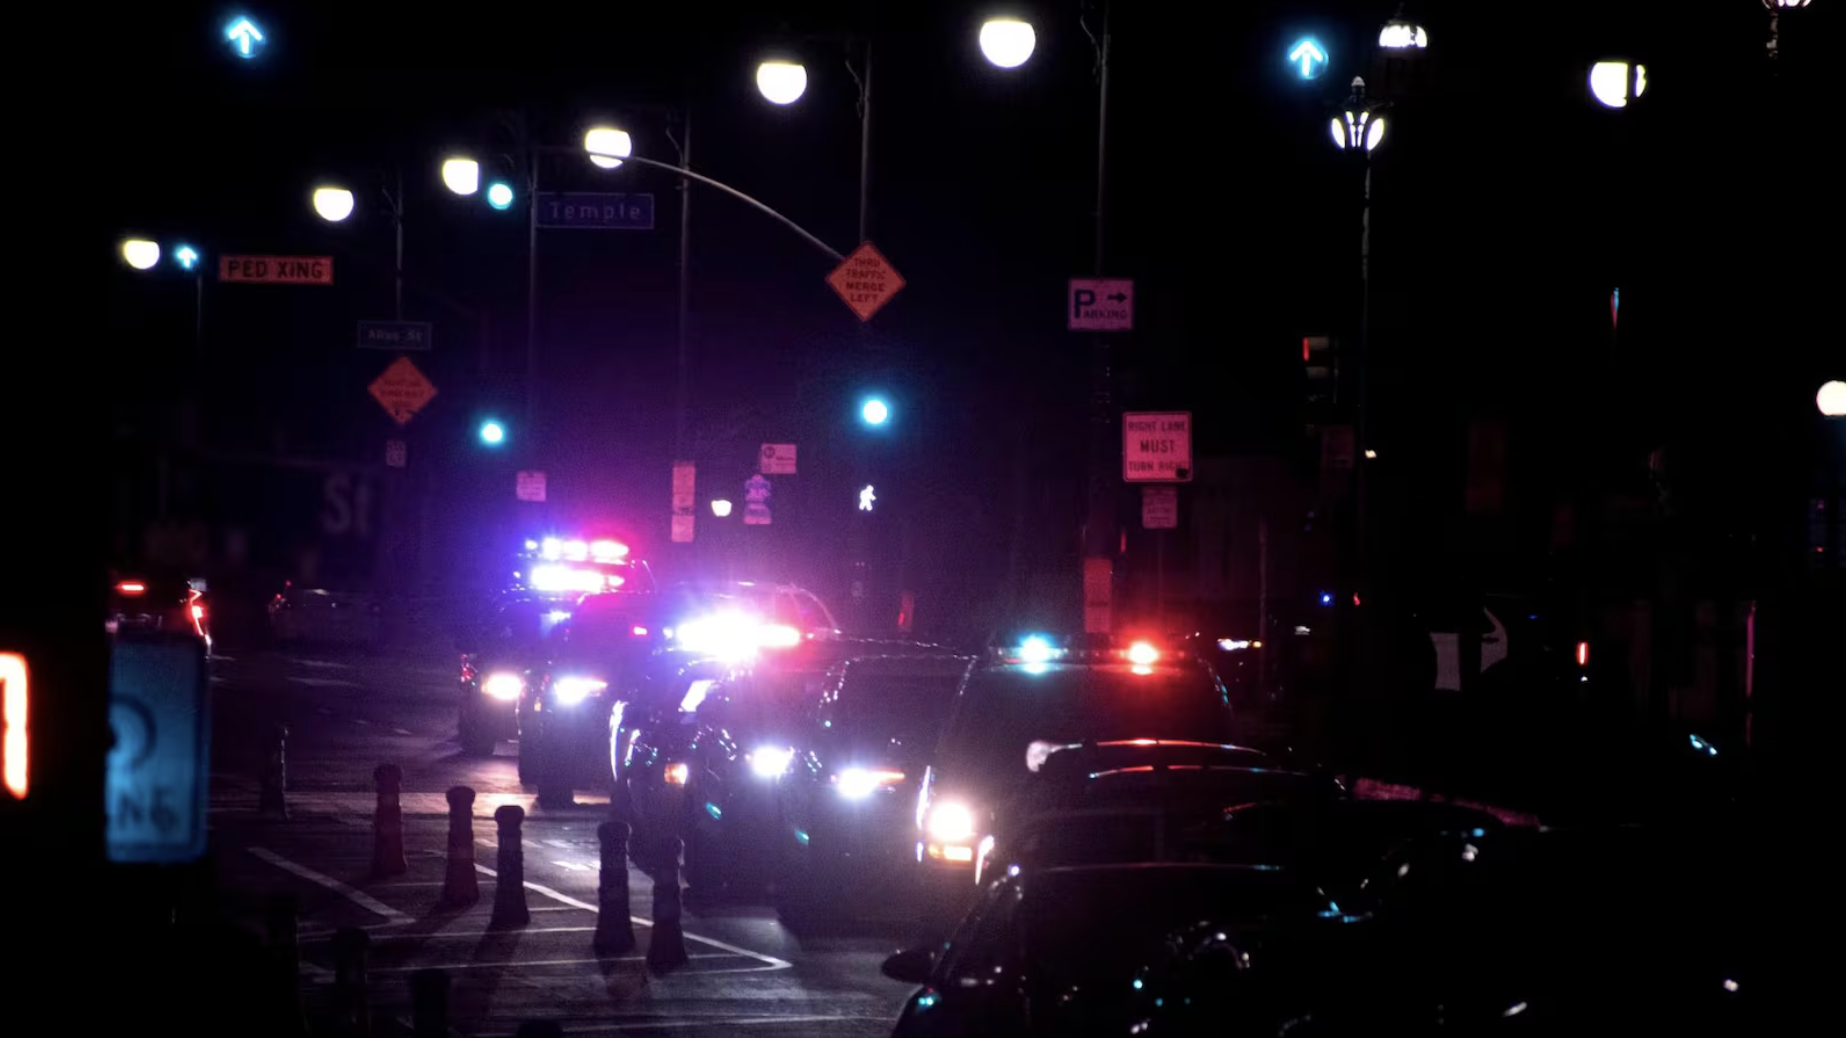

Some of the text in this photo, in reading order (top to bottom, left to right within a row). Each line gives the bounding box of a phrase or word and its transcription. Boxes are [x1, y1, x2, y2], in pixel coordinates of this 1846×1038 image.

[548, 200, 641, 223] Temple
[228, 260, 323, 278] PED XING
[846, 282, 886, 292] MERGE
[850, 293, 878, 302] LEFT
[1127, 421, 1186, 432] RIGHT LANE
[1140, 439, 1175, 453] MUST
[1127, 460, 1155, 472] TURN
